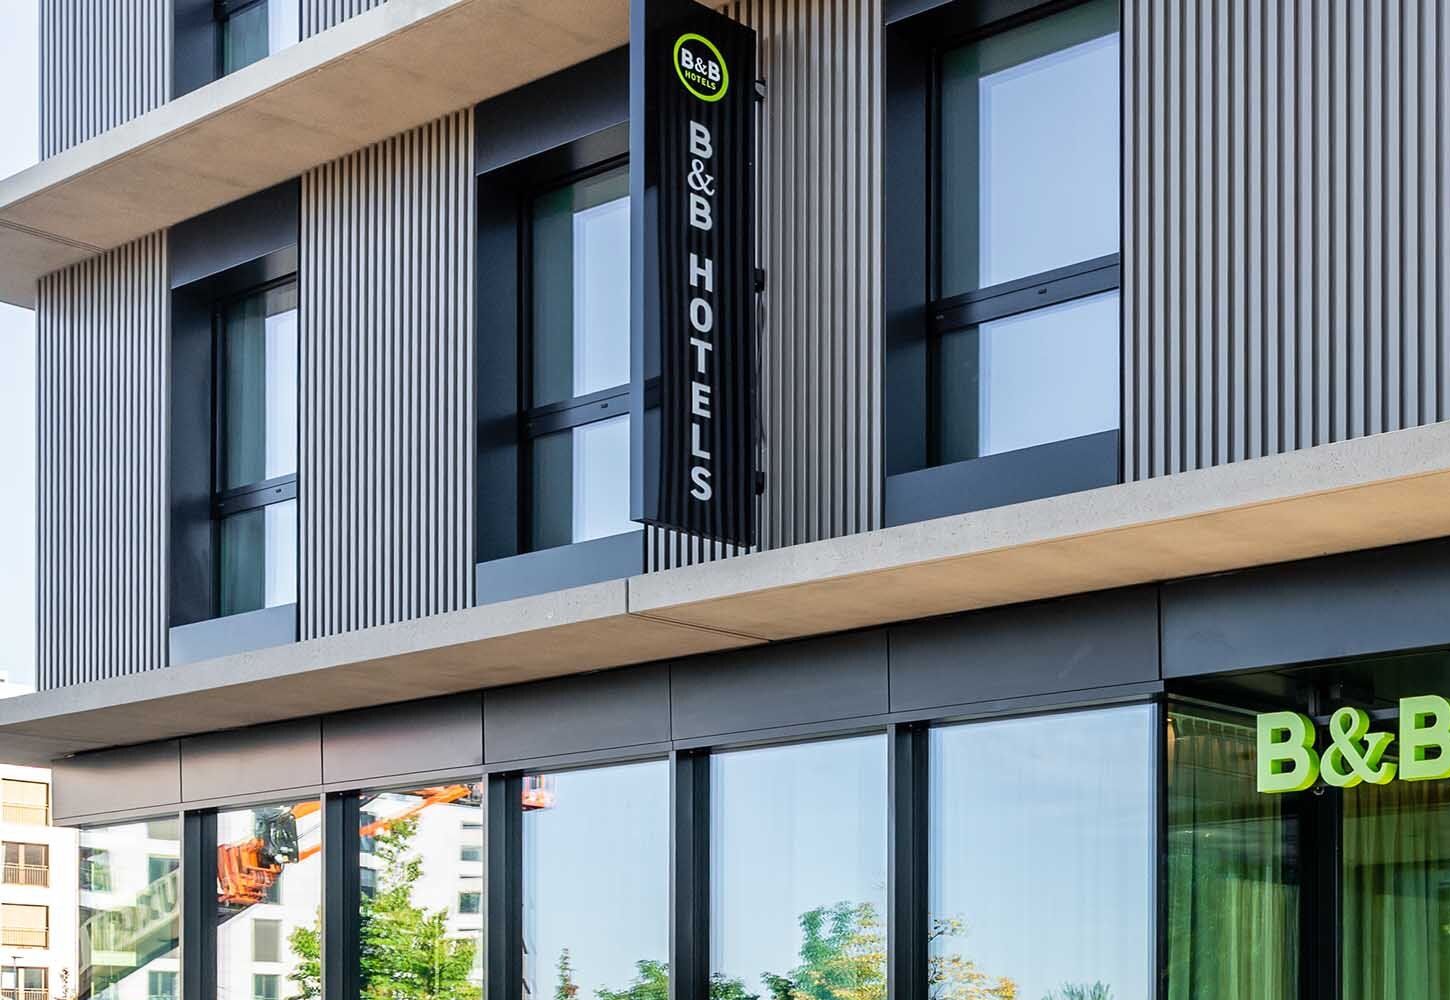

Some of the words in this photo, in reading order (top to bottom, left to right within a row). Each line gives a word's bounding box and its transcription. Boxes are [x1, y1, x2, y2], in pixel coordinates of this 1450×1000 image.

[681, 47, 721, 82] B&B
[684, 69, 717, 91] HOTELS
[687, 119, 716, 231] B&B
[689, 252, 714, 502] HOTELS
